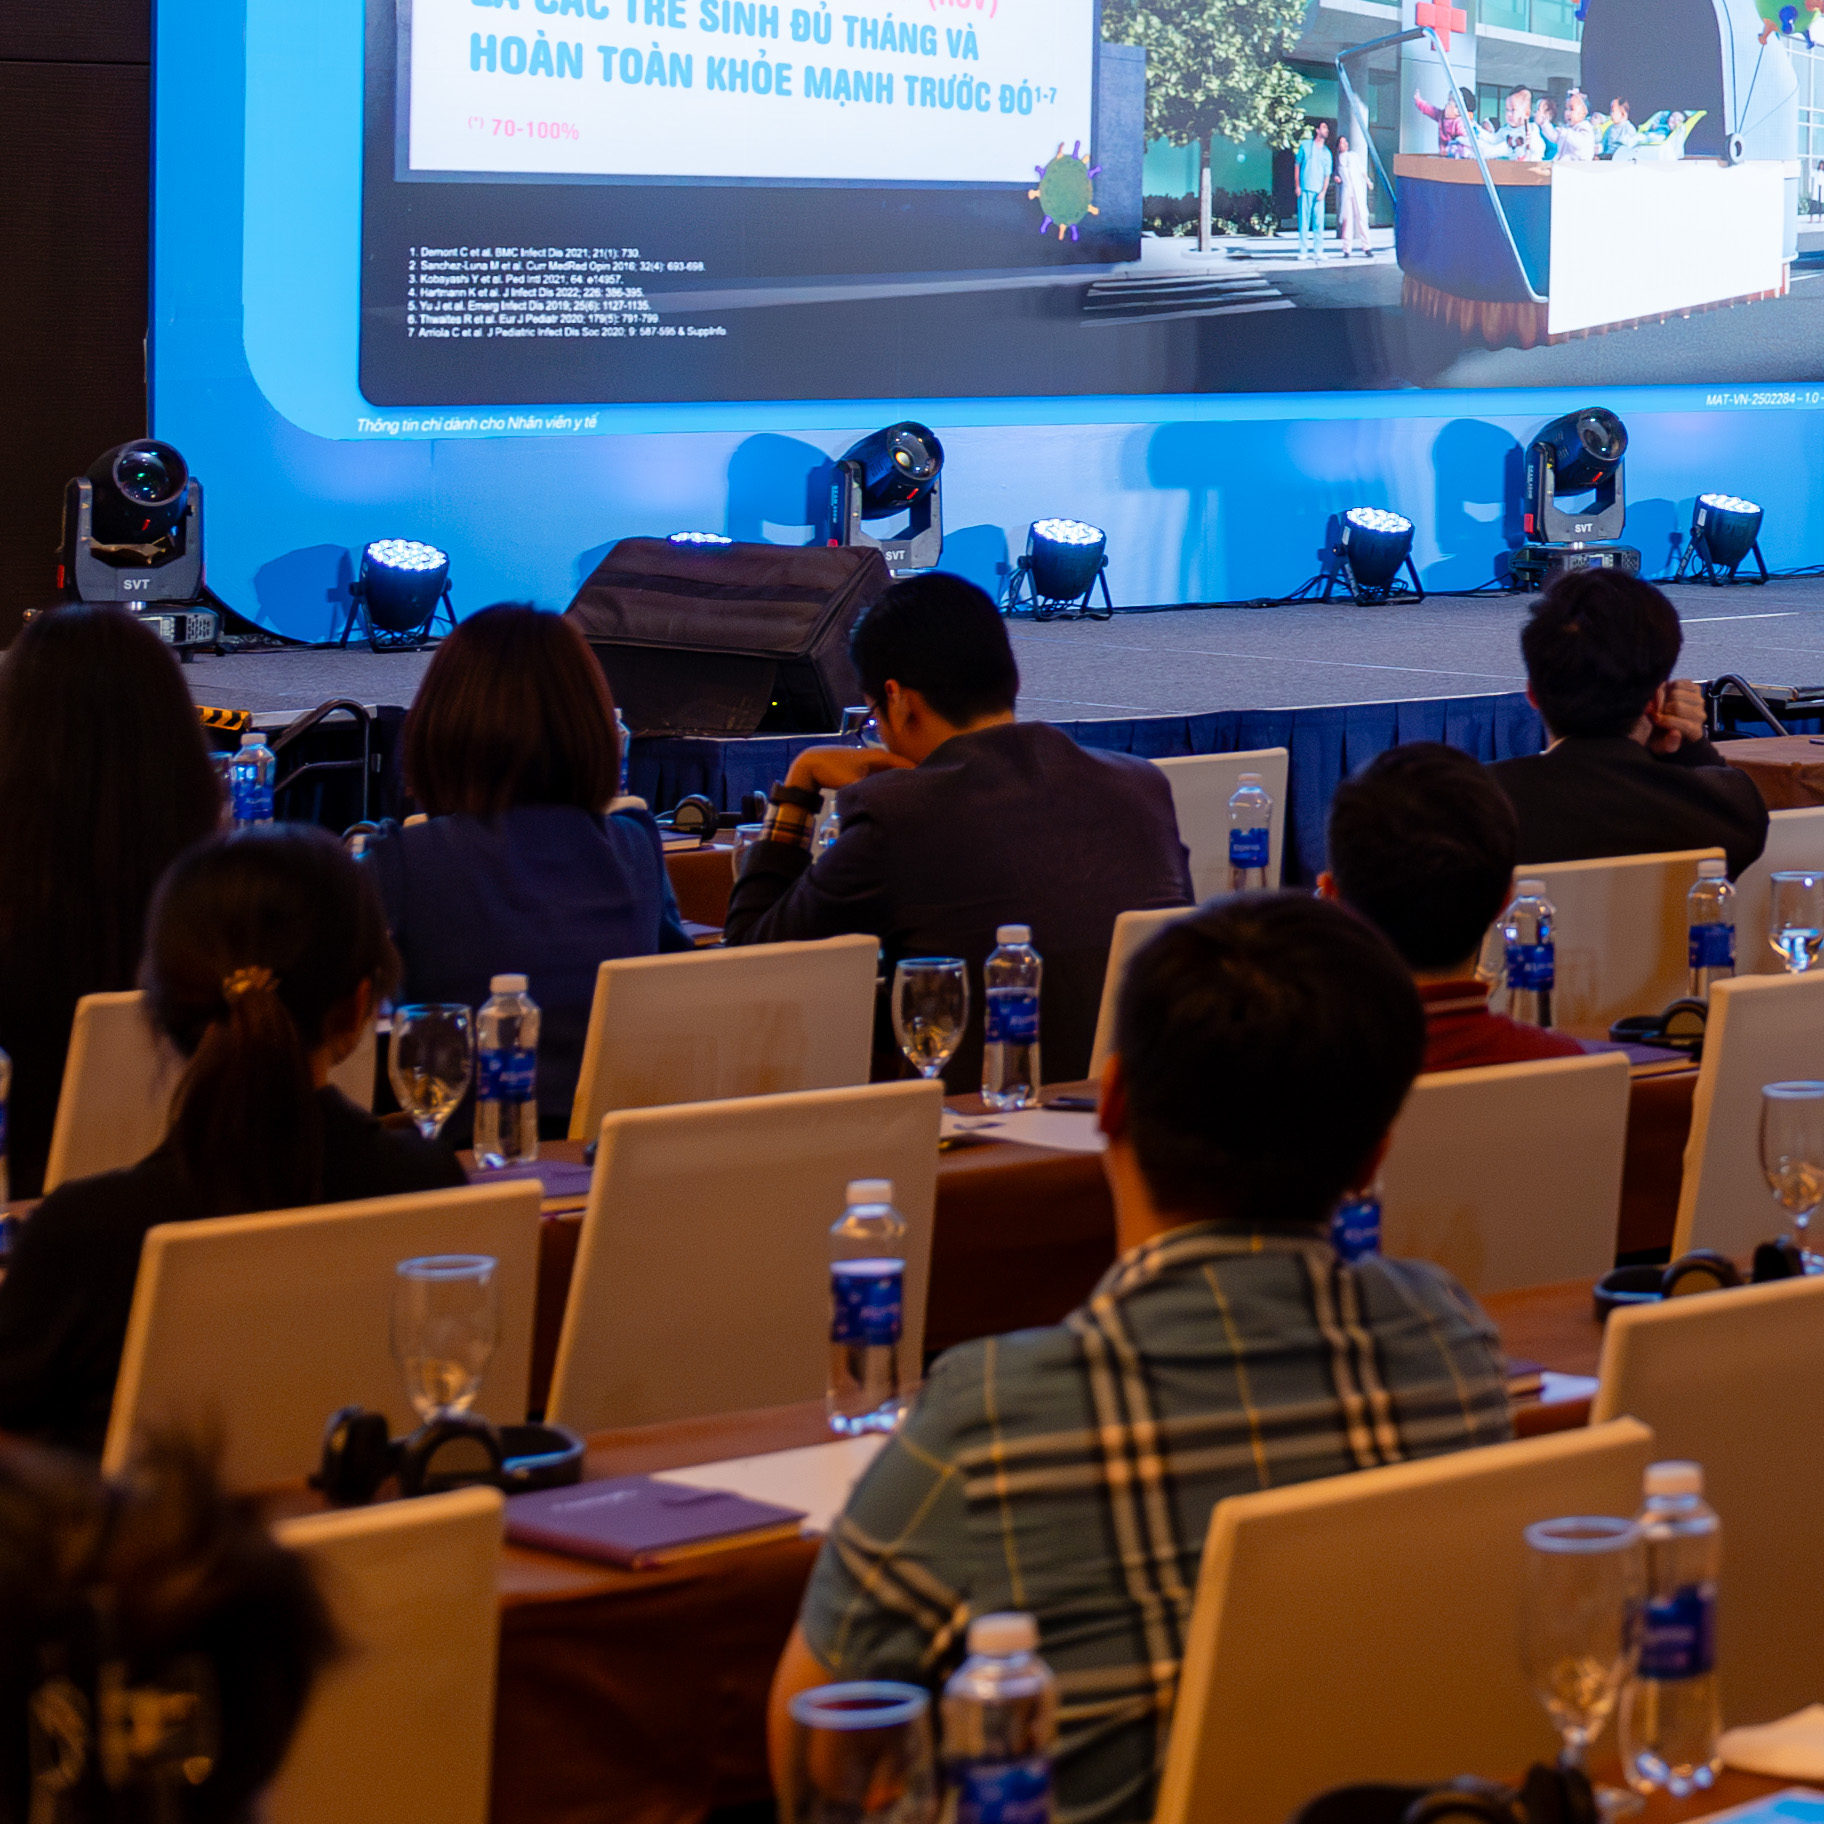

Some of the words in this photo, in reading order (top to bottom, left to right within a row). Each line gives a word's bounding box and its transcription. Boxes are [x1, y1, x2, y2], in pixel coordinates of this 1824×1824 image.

[791, 3, 832, 46] ĐỦ
[842, 10, 939, 56] THÁNG
[946, 23, 980, 62] VÀ
[470, 30, 584, 80] HOÀN
[597, 41, 694, 89] TOÀN
[706, 49, 794, 98] KHỎE
[803, 65, 895, 108] MẠNH
[904, 70, 991, 113] TRƯỚC
[491, 117, 580, 141] 70-100%
[459, 247, 468, 257] C
[495, 247, 519, 257] BMC
[520, 247, 546, 257] Infect
[1706, 392, 1796, 406] MAT-VN-2502284
[1805, 392, 1820, 404] 1.0
[358, 418, 400, 435] Thông
[402, 418, 419, 432] tin
[444, 416, 478, 431] dành
[480, 416, 504, 430] cho
[507, 415, 543, 430] Nhân
[545, 414, 572, 429] viên
[574, 417, 582, 430] y
[584, 412, 600, 428] tế
[1574, 523, 1593, 533] SVT
[885, 550, 905, 561] SVT
[123, 579, 150, 590] SVT
